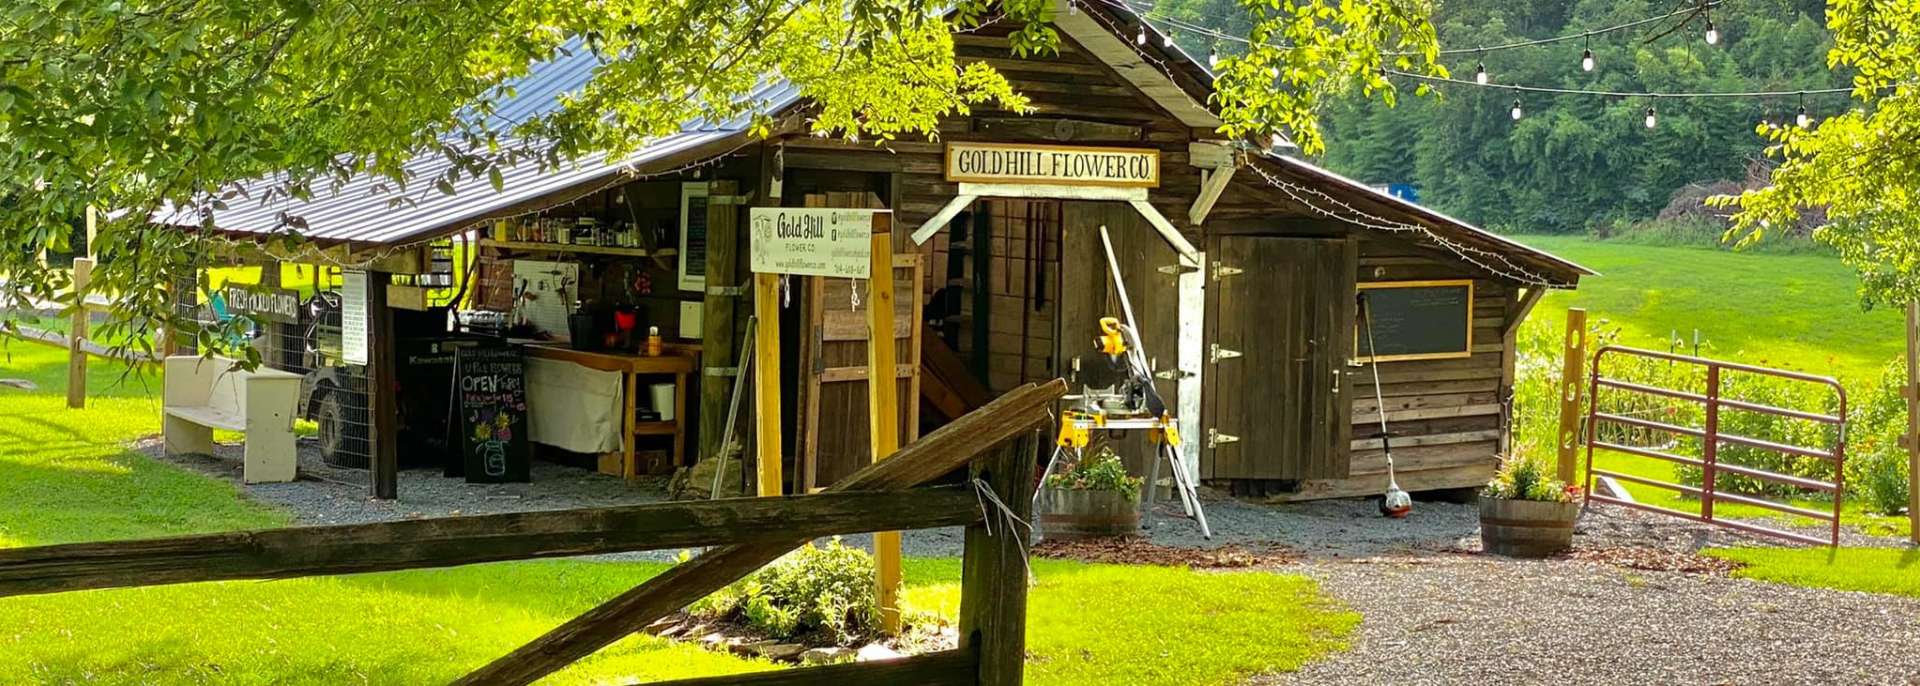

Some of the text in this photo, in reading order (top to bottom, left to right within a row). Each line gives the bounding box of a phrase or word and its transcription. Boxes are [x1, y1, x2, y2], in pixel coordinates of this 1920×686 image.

[958, 149, 1001, 175] GOLD
[1005, 150, 1047, 176] HILL
[1052, 152, 1127, 178] FLOWER
[777, 212, 802, 239] Gold
[803, 214, 825, 239] Hill
[785, 243, 806, 253] FLOWER
[229, 287, 248, 309] FRESH
[462, 375, 498, 393] OPEN
